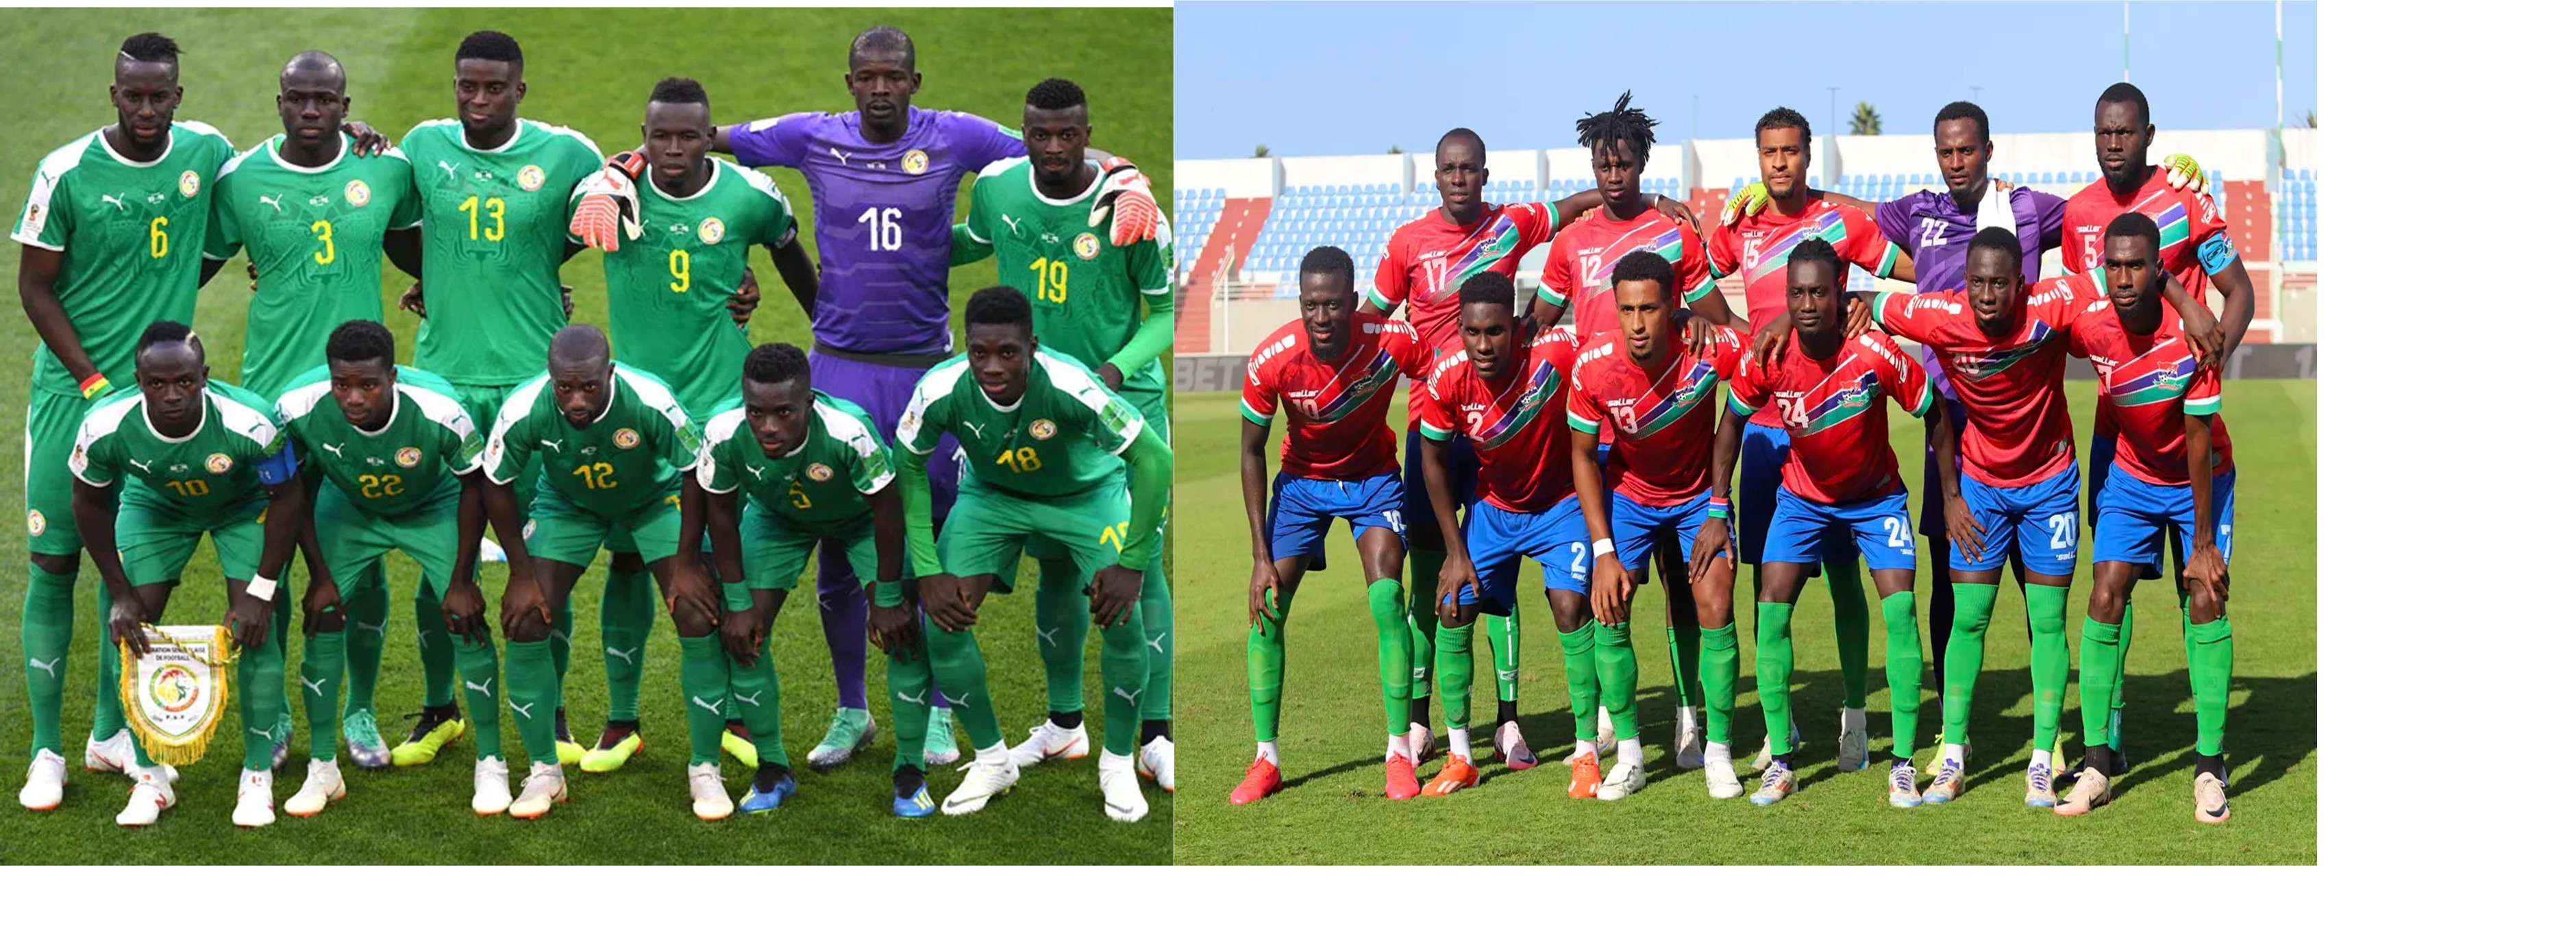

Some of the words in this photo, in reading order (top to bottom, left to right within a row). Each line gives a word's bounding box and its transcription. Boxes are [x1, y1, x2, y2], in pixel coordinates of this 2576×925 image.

[459, 196, 505, 242] 13
[858, 207, 902, 251] 16
[1920, 217, 1949, 247] 22
[150, 216, 169, 258] 6
[312, 220, 335, 265] 3
[2084, 234, 2098, 269] 5
[1743, 238, 1759, 271] 15
[669, 249, 690, 293] 9
[1030, 256, 1067, 304] 19
[1422, 256, 1447, 293] 17
[1580, 255, 1602, 288] 12
[1174, 358, 1241, 391] BET
[2090, 354, 2118, 366] saller
[1289, 389, 1319, 398] saller
[1773, 390, 1805, 398] saller
[2097, 365, 2113, 395] 7
[1605, 398, 1636, 407] saller
[1776, 397, 1809, 428] 24
[1467, 411, 1485, 443] 2
[1610, 406, 1638, 434] 13
[573, 461, 617, 489] 12
[996, 446, 1043, 474] 18
[164, 479, 210, 497] 10
[358, 474, 404, 499] 22
[789, 481, 812, 509] 5
[1883, 516, 1914, 547] 24
[2049, 511, 2076, 550] 20
[1571, 541, 1587, 573] 2
